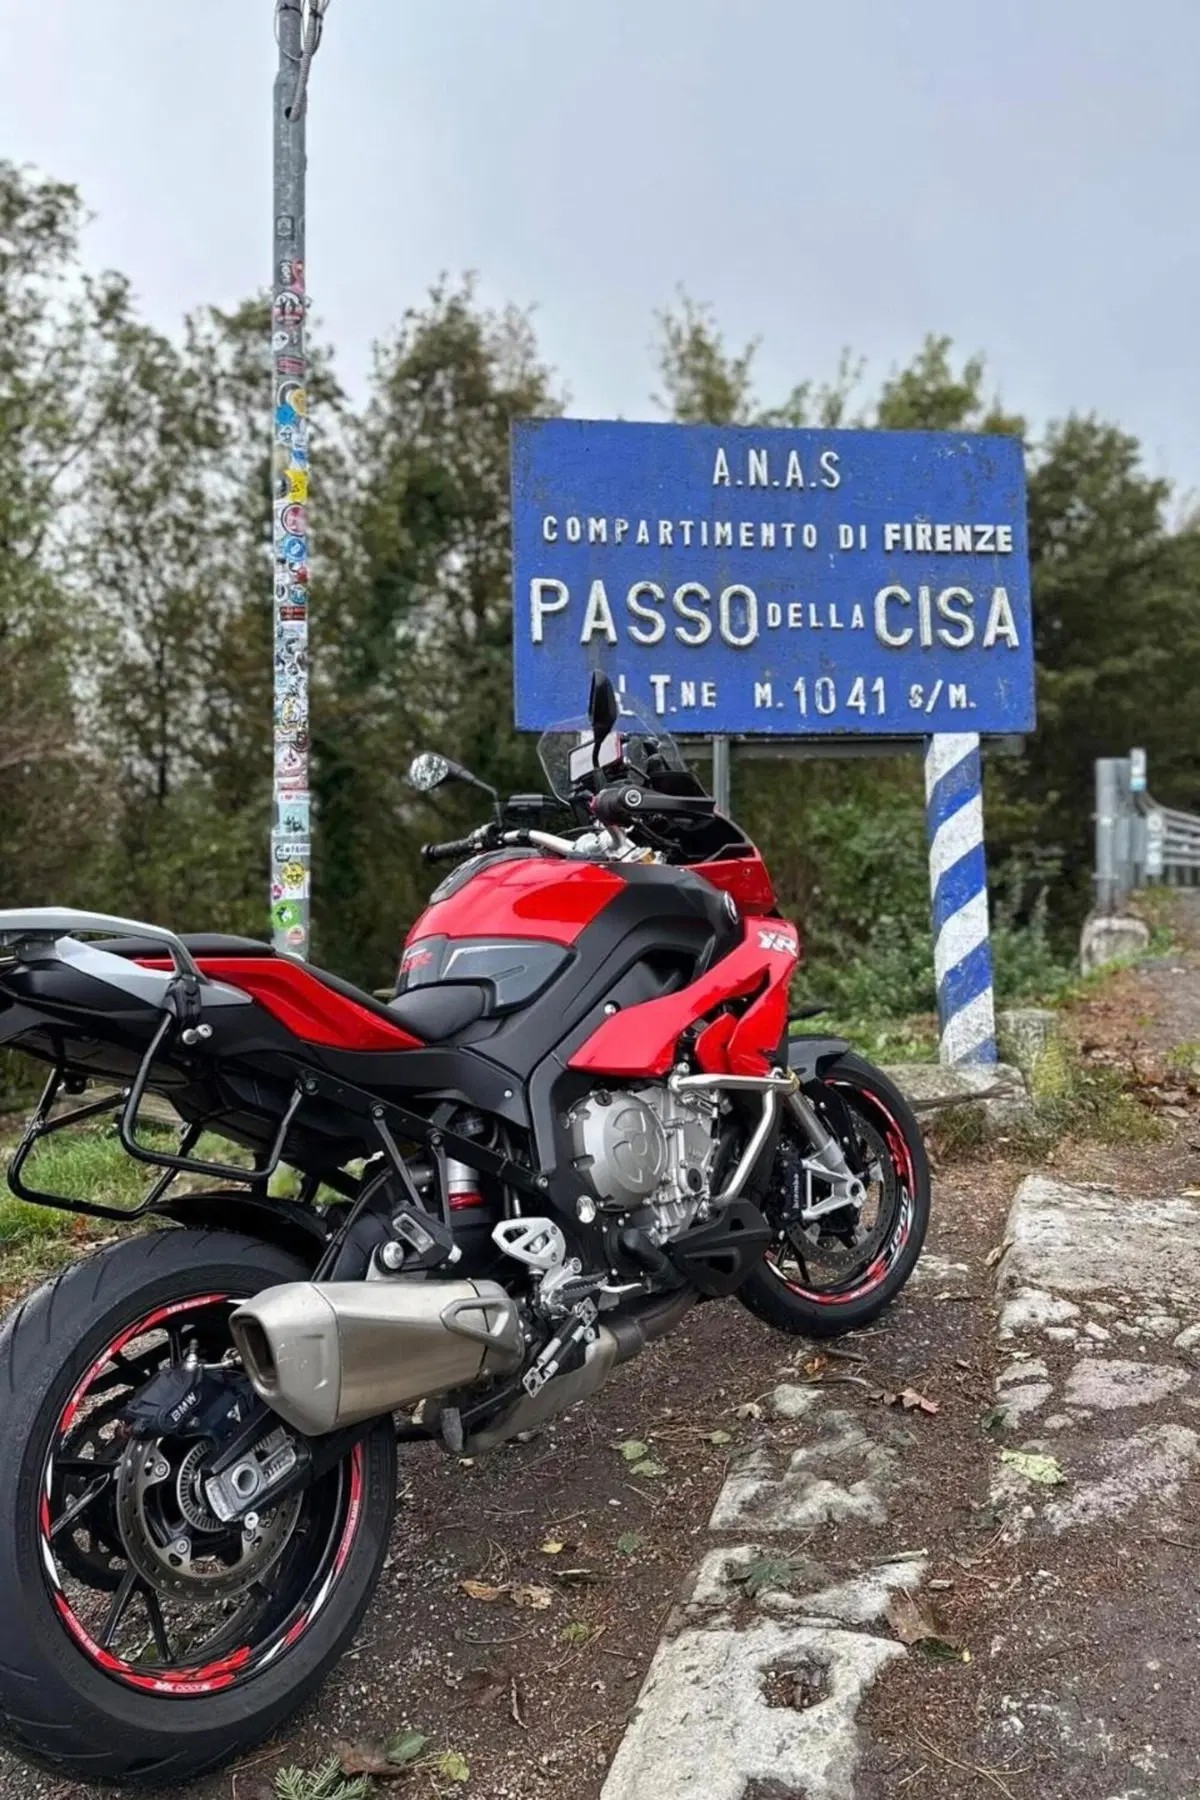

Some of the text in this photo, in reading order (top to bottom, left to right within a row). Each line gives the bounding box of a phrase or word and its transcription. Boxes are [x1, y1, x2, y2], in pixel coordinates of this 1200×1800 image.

[712, 447, 841, 488] A.N.A.S
[543, 515, 1013, 553] COMPARTIMENTO DI FIRENZE
[530, 577, 1020, 648] PASSO DELLA CISA
[170, 1391, 197, 1422] BMW
